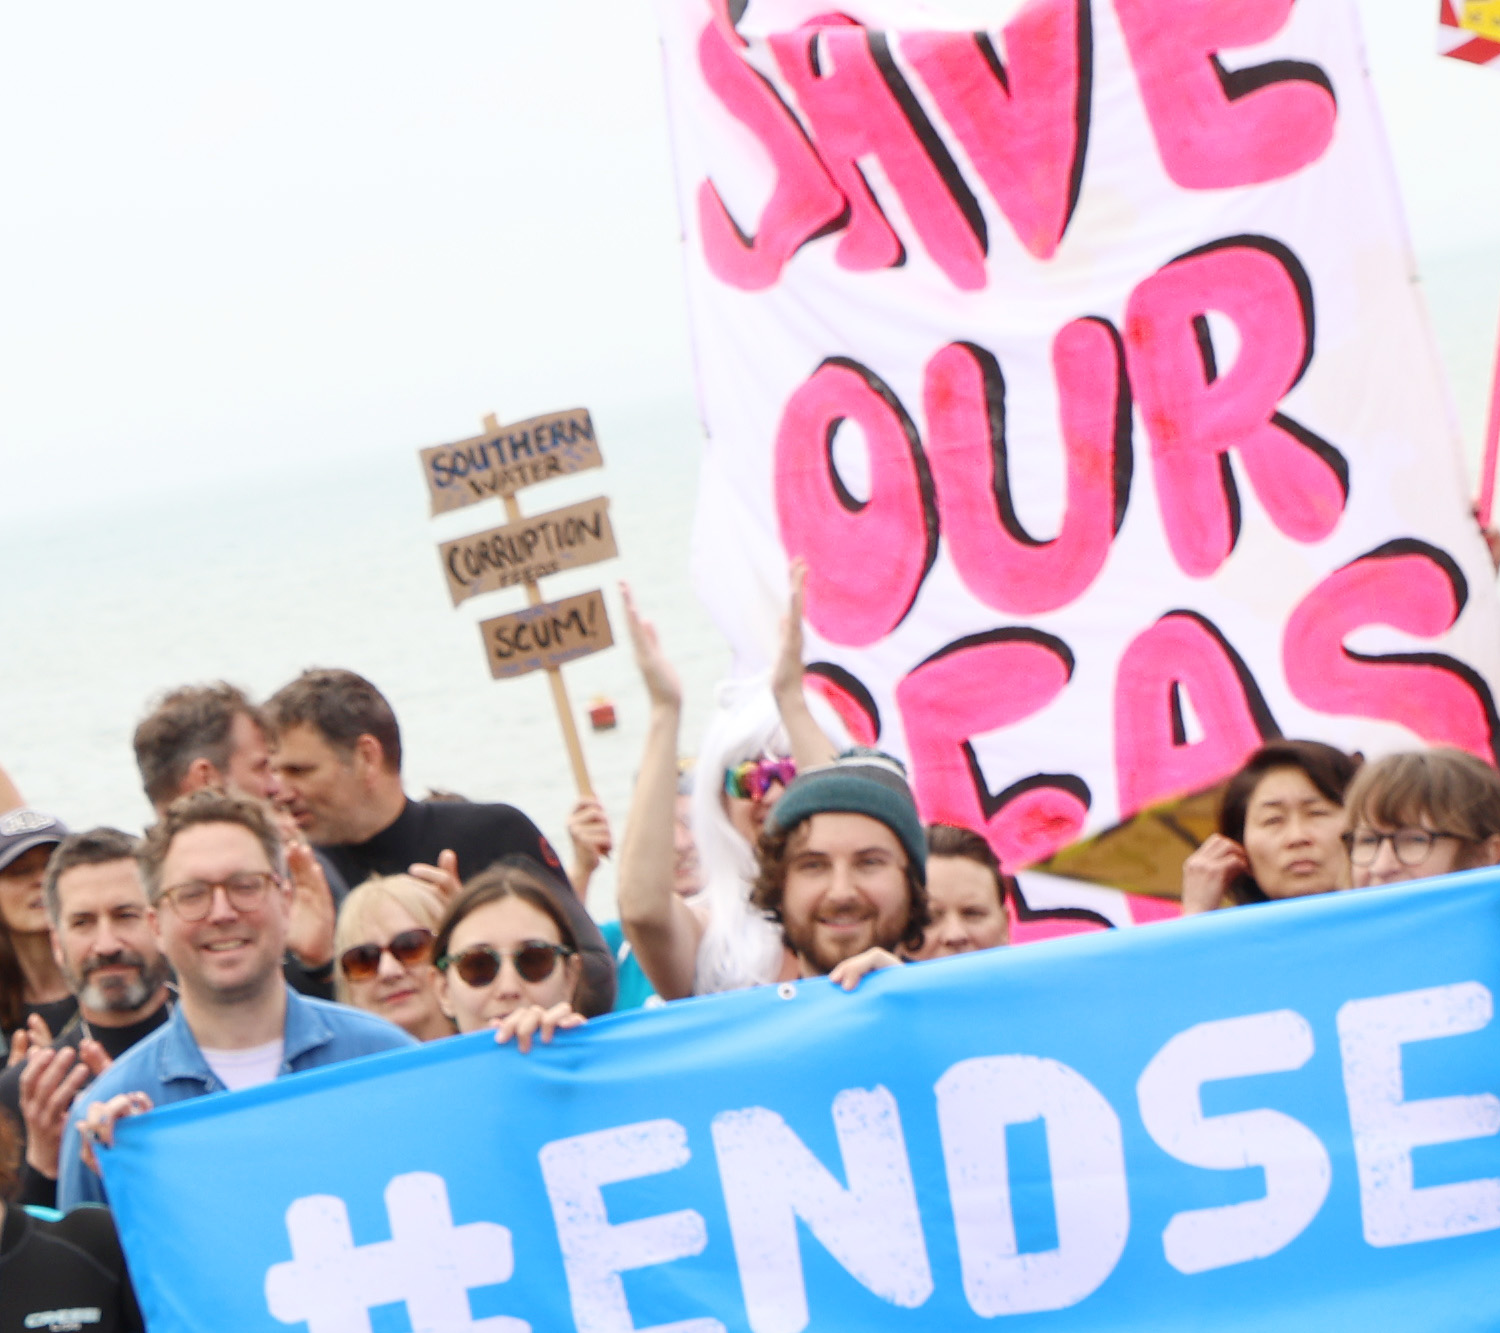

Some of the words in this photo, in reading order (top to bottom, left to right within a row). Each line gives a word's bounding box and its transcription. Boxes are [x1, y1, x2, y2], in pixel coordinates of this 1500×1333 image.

[697, 0, 1336, 292] SAVE
[430, 415, 595, 488] SOUTHERN
[774, 232, 1350, 646] OUR
[447, 511, 602, 586] CORRUPTION
[495, 599, 598, 659] SCUM!
